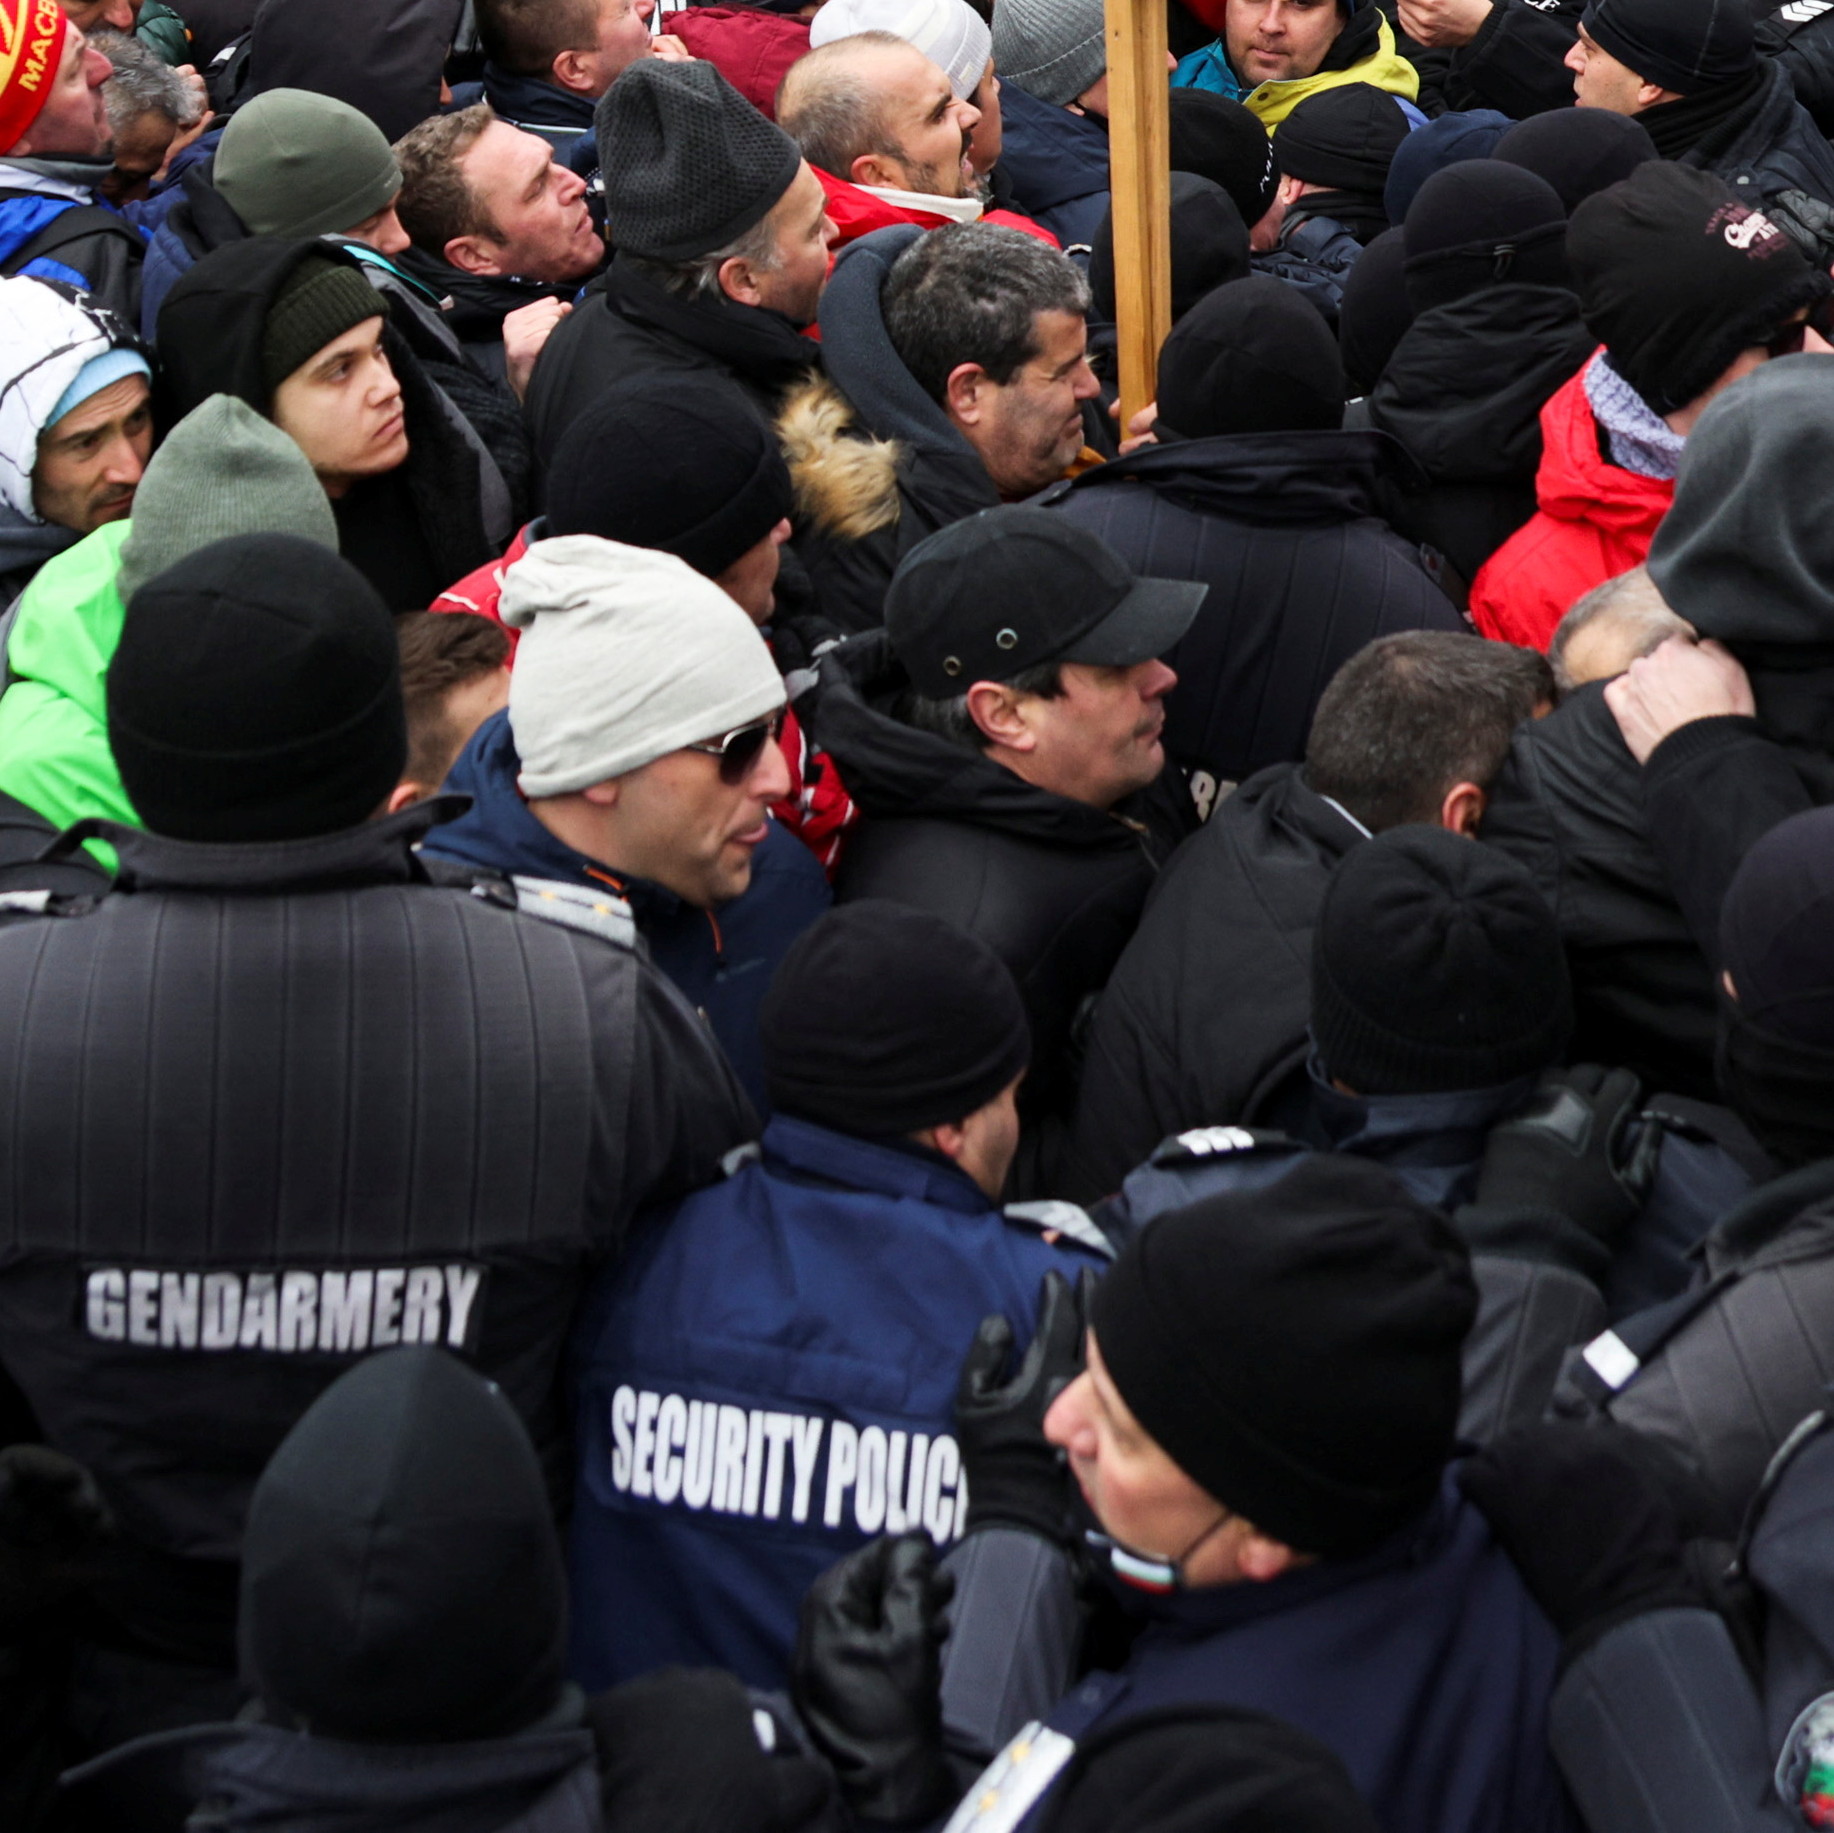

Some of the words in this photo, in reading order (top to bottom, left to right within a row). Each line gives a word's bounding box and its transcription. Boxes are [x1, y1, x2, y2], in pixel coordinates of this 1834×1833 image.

[84, 1263, 481, 1352] GENDARMERY
[611, 1384, 826, 1523] SECURITY
[822, 1420, 969, 1545] POLIC
